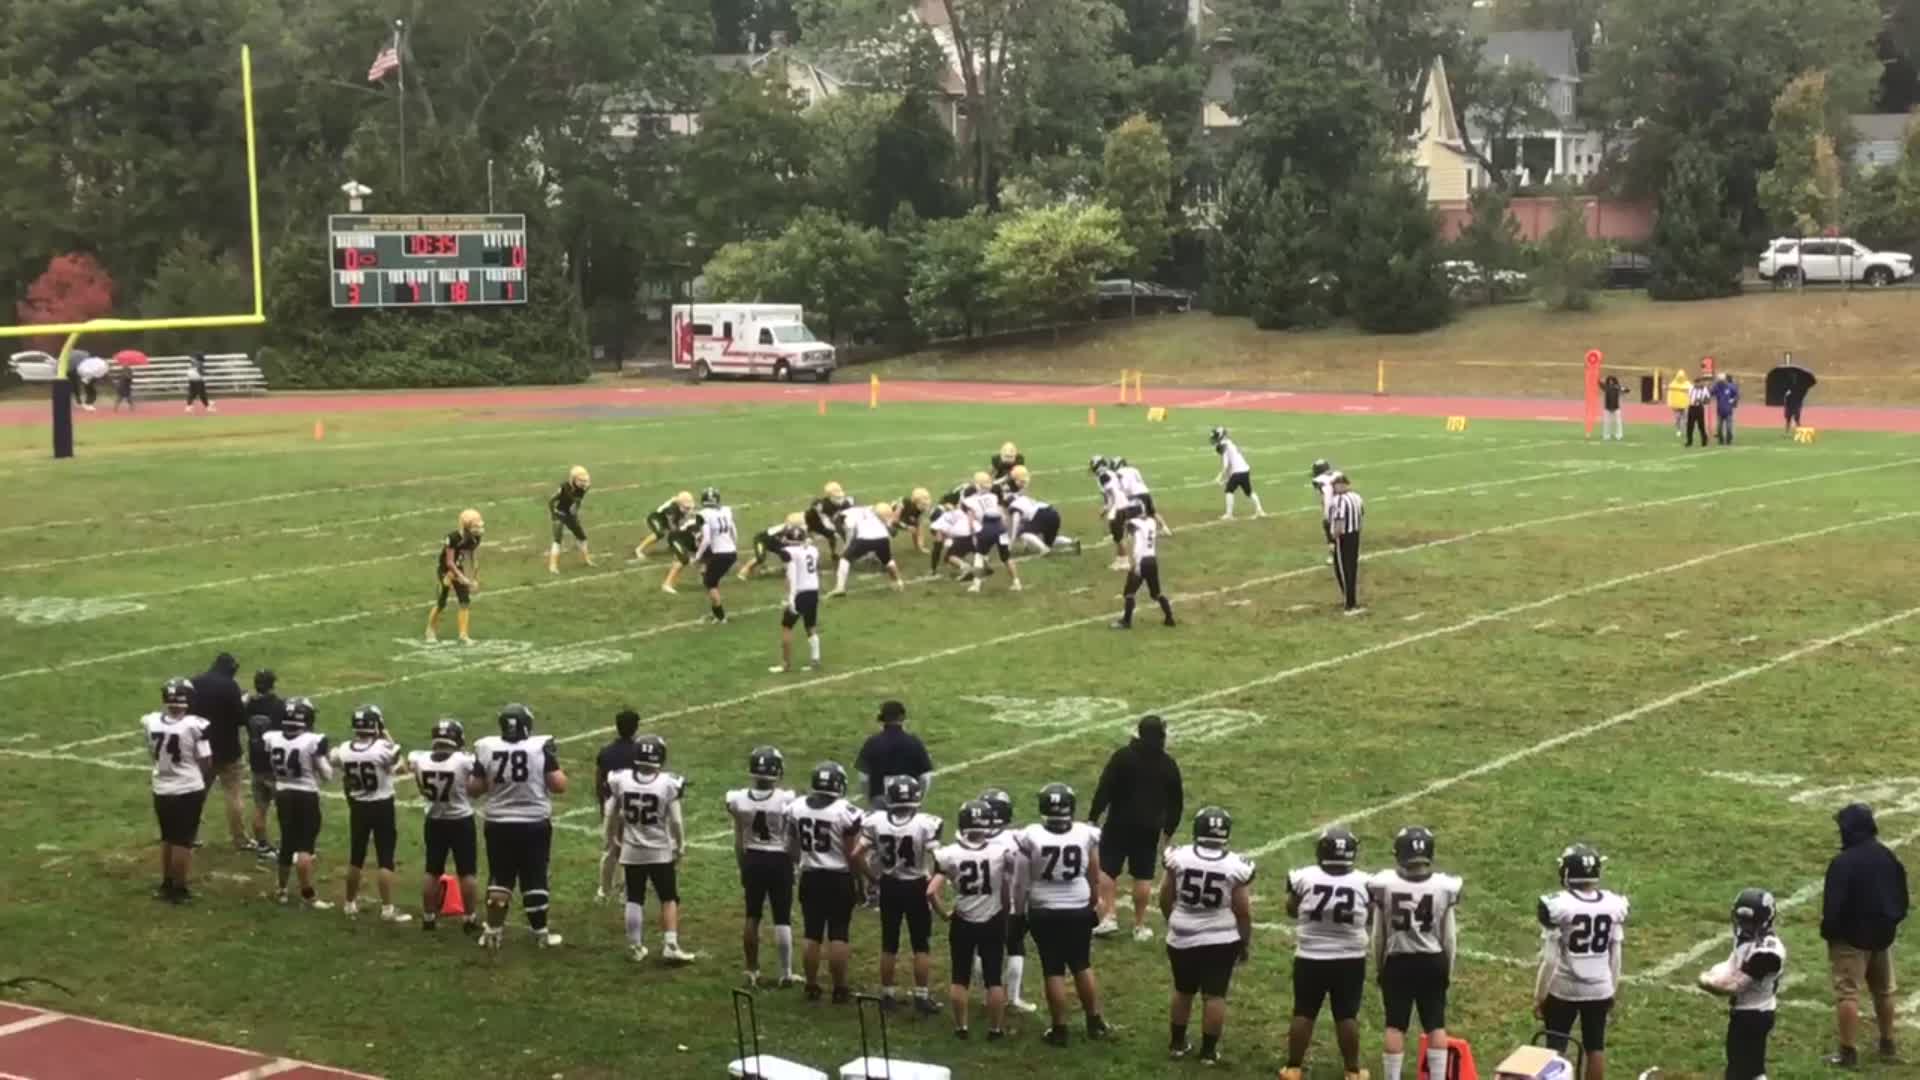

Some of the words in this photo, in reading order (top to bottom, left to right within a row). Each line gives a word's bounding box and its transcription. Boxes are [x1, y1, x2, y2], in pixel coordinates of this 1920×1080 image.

[151, 731, 181, 764] 74
[271, 747, 301, 777] 24
[492, 750, 529, 783] 78
[422, 771, 455, 802] 57
[623, 792, 659, 825] 52
[752, 811, 771, 841] 4
[799, 817, 832, 853] 65
[878, 834, 915, 868] 34
[959, 859, 992, 896] 21
[1041, 845, 1082, 881] 79
[1182, 868, 1226, 908] 55
[1310, 884, 1355, 923] 72
[1391, 892, 1434, 932] 54
[1568, 914, 1612, 953] 28
